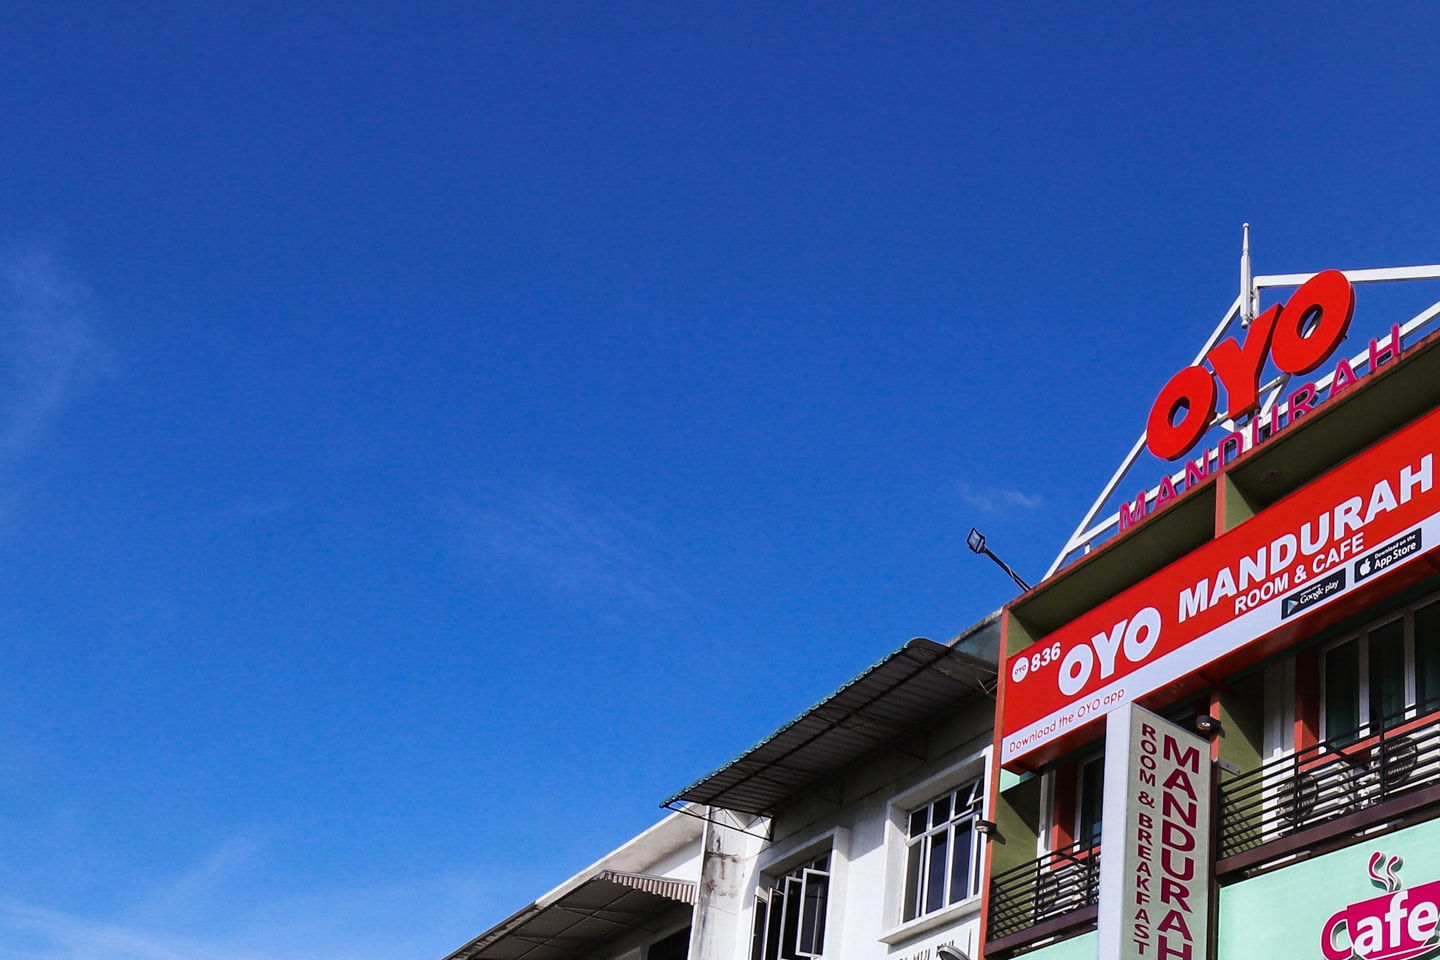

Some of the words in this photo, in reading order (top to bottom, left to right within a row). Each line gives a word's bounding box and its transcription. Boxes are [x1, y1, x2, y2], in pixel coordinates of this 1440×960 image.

[1146, 269, 1354, 461] OYO
[1119, 322, 1401, 533] MANDURAH
[1058, 607, 1162, 696] OYO
[1178, 453, 1433, 624] MANDURAH
[1234, 572, 1289, 615] ROOM
[1294, 564, 1307, 583] &
[1311, 531, 1364, 573] CAFE
[1374, 554, 1392, 570] App
[1393, 542, 1417, 560] Store
[1300, 586, 1324, 604] Google
[1325, 580, 1339, 595] play
[1014, 664, 1027, 676] OYO
[1031, 642, 1061, 672] 836
[1009, 718, 1056, 753] Download
[1059, 713, 1074, 728] the
[1077, 699, 1101, 718] OYO
[1103, 688, 1125, 705] app
[1138, 723, 1157, 787] ROOM
[1138, 791, 1155, 809] &
[1133, 812, 1153, 955] BREAKFAST
